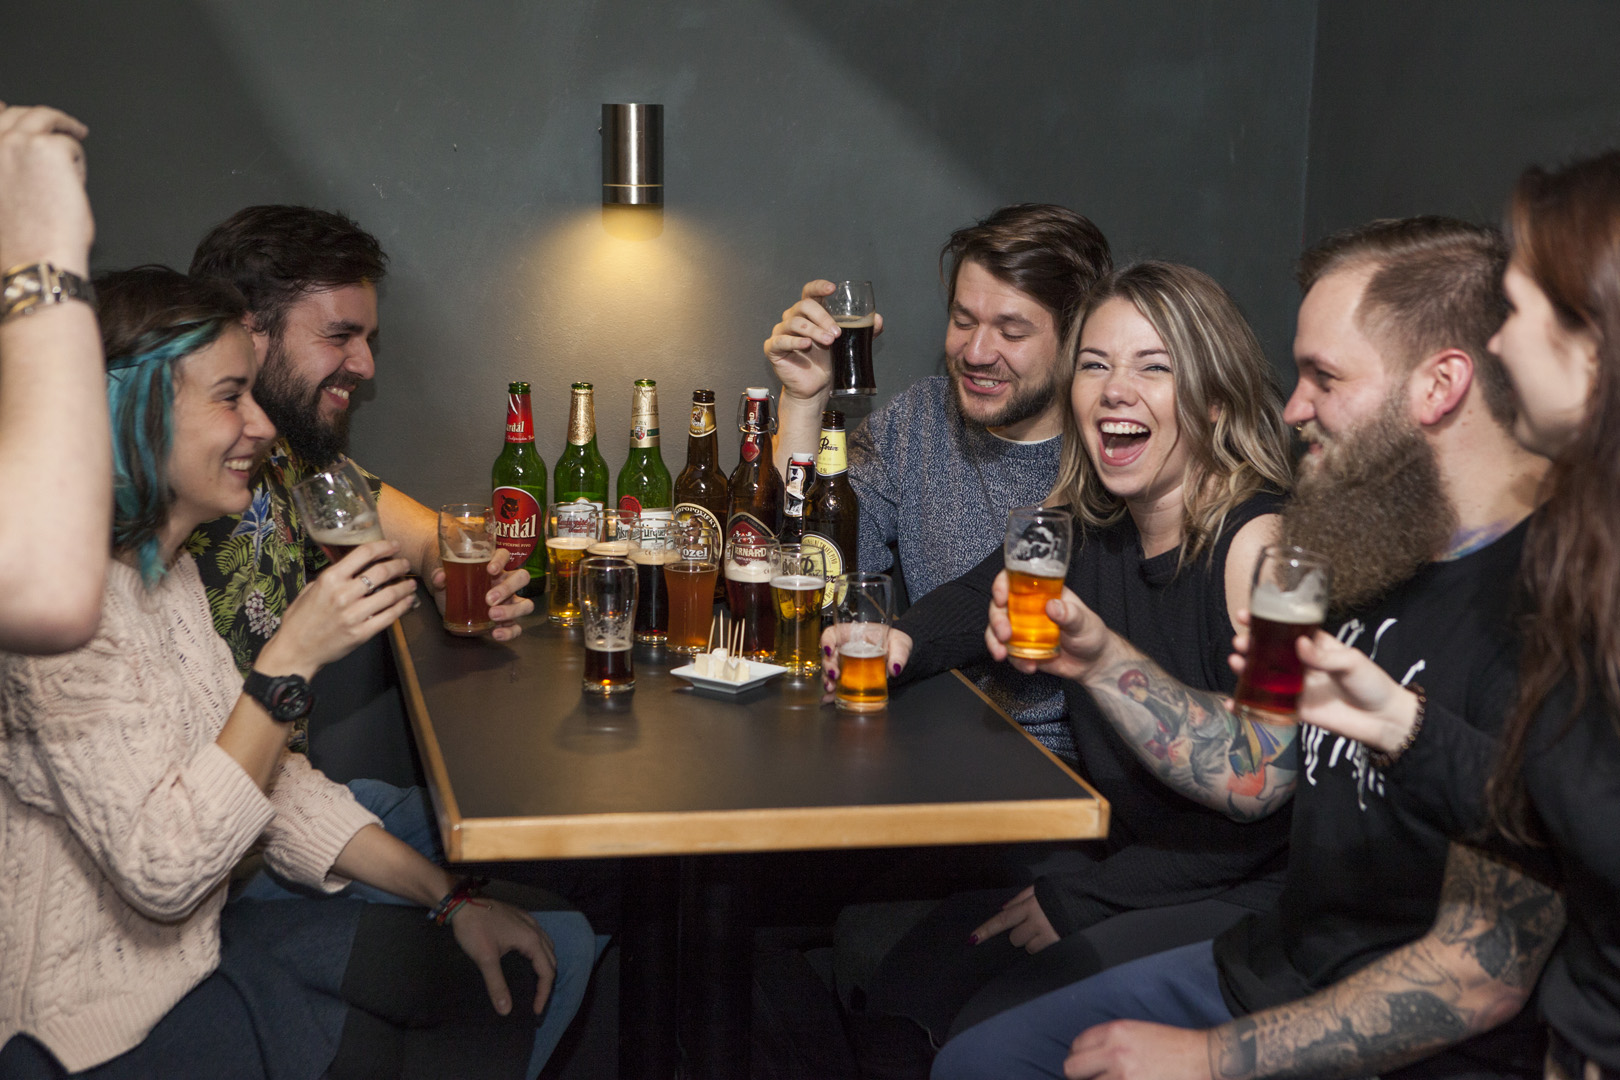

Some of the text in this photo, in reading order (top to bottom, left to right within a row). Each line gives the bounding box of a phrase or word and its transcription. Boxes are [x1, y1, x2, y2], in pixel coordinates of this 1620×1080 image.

[506, 420, 525, 433] ardál
[494, 514, 537, 539] ardál
[682, 546, 708, 557] ozel
[735, 546, 767, 558] ERNARD
